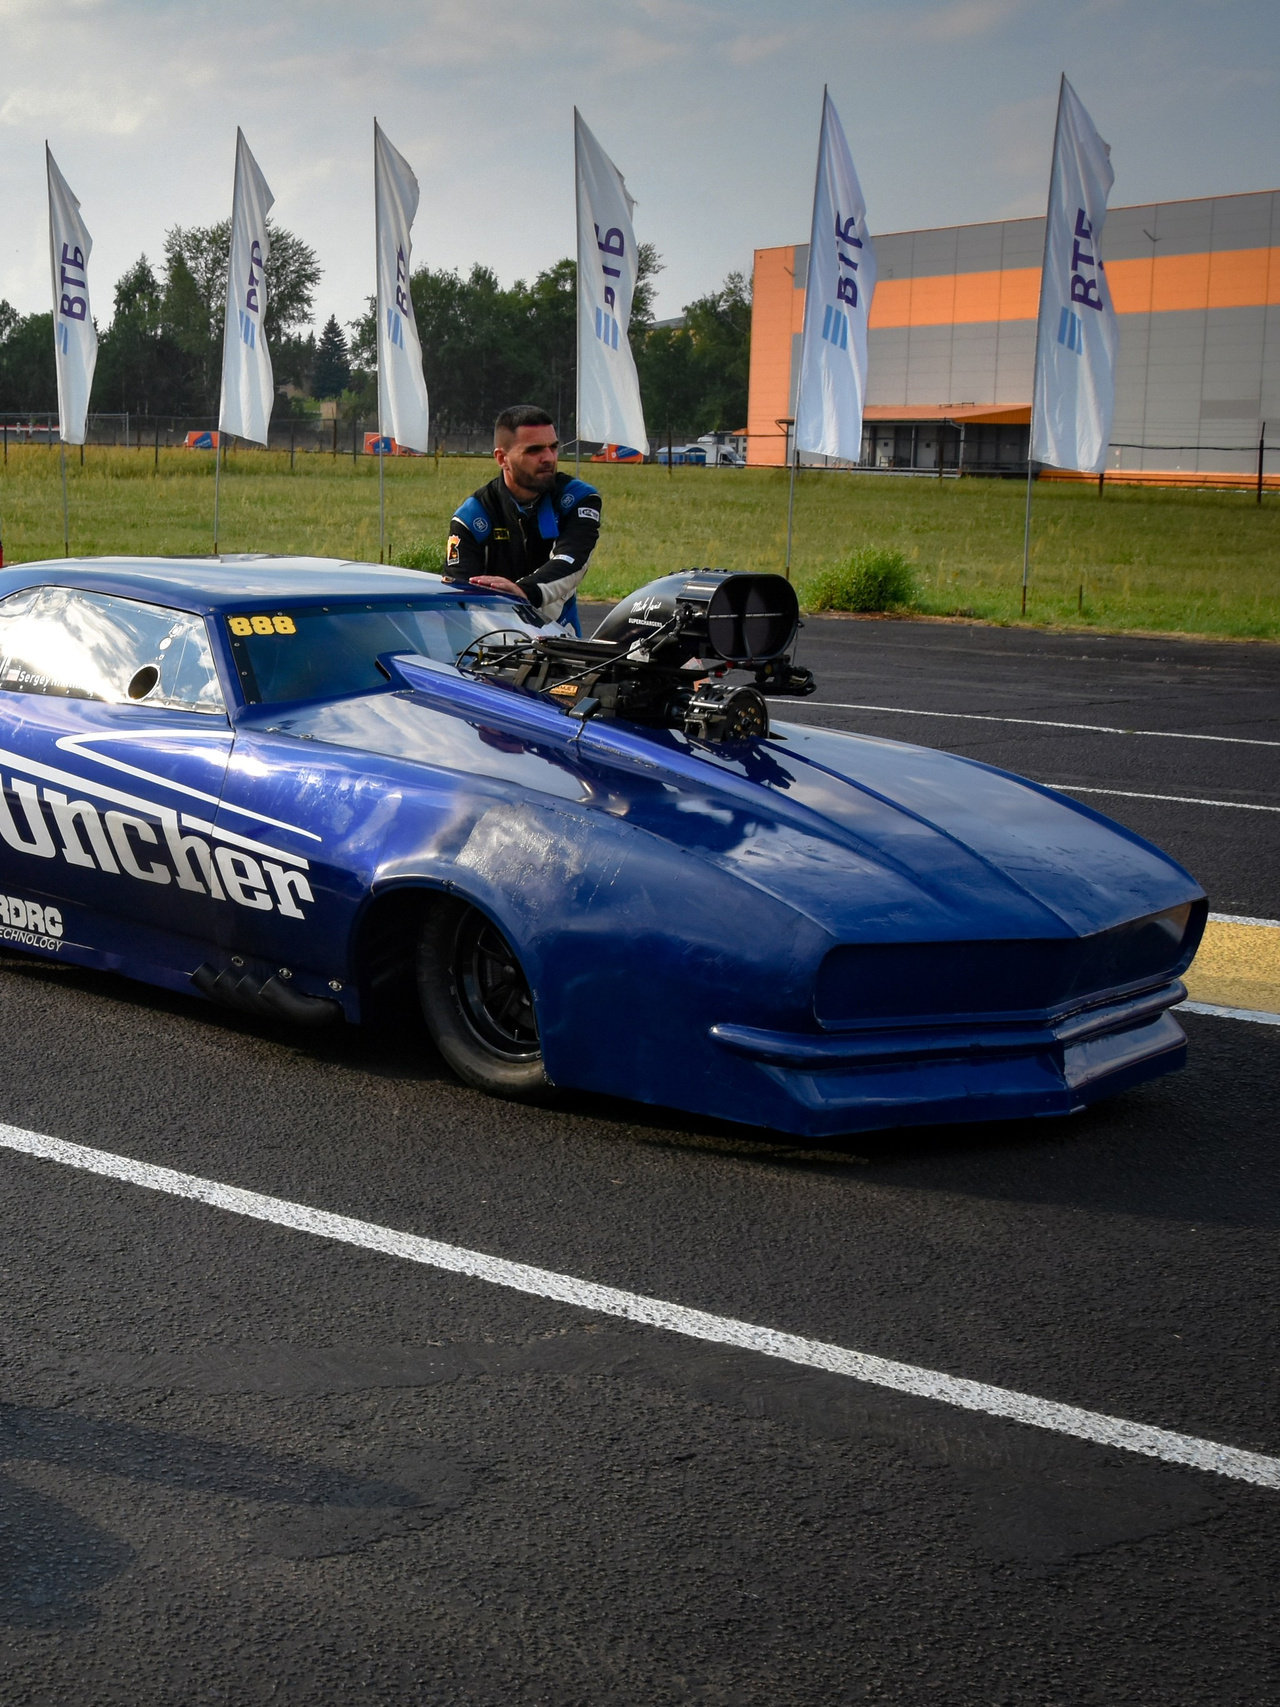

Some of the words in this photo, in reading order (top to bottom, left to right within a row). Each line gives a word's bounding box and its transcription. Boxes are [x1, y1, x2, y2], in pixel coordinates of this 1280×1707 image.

[59, 242, 87, 322] ВТБ
[228, 615, 297, 636] 888
[19, 670, 50, 687] Sergey
